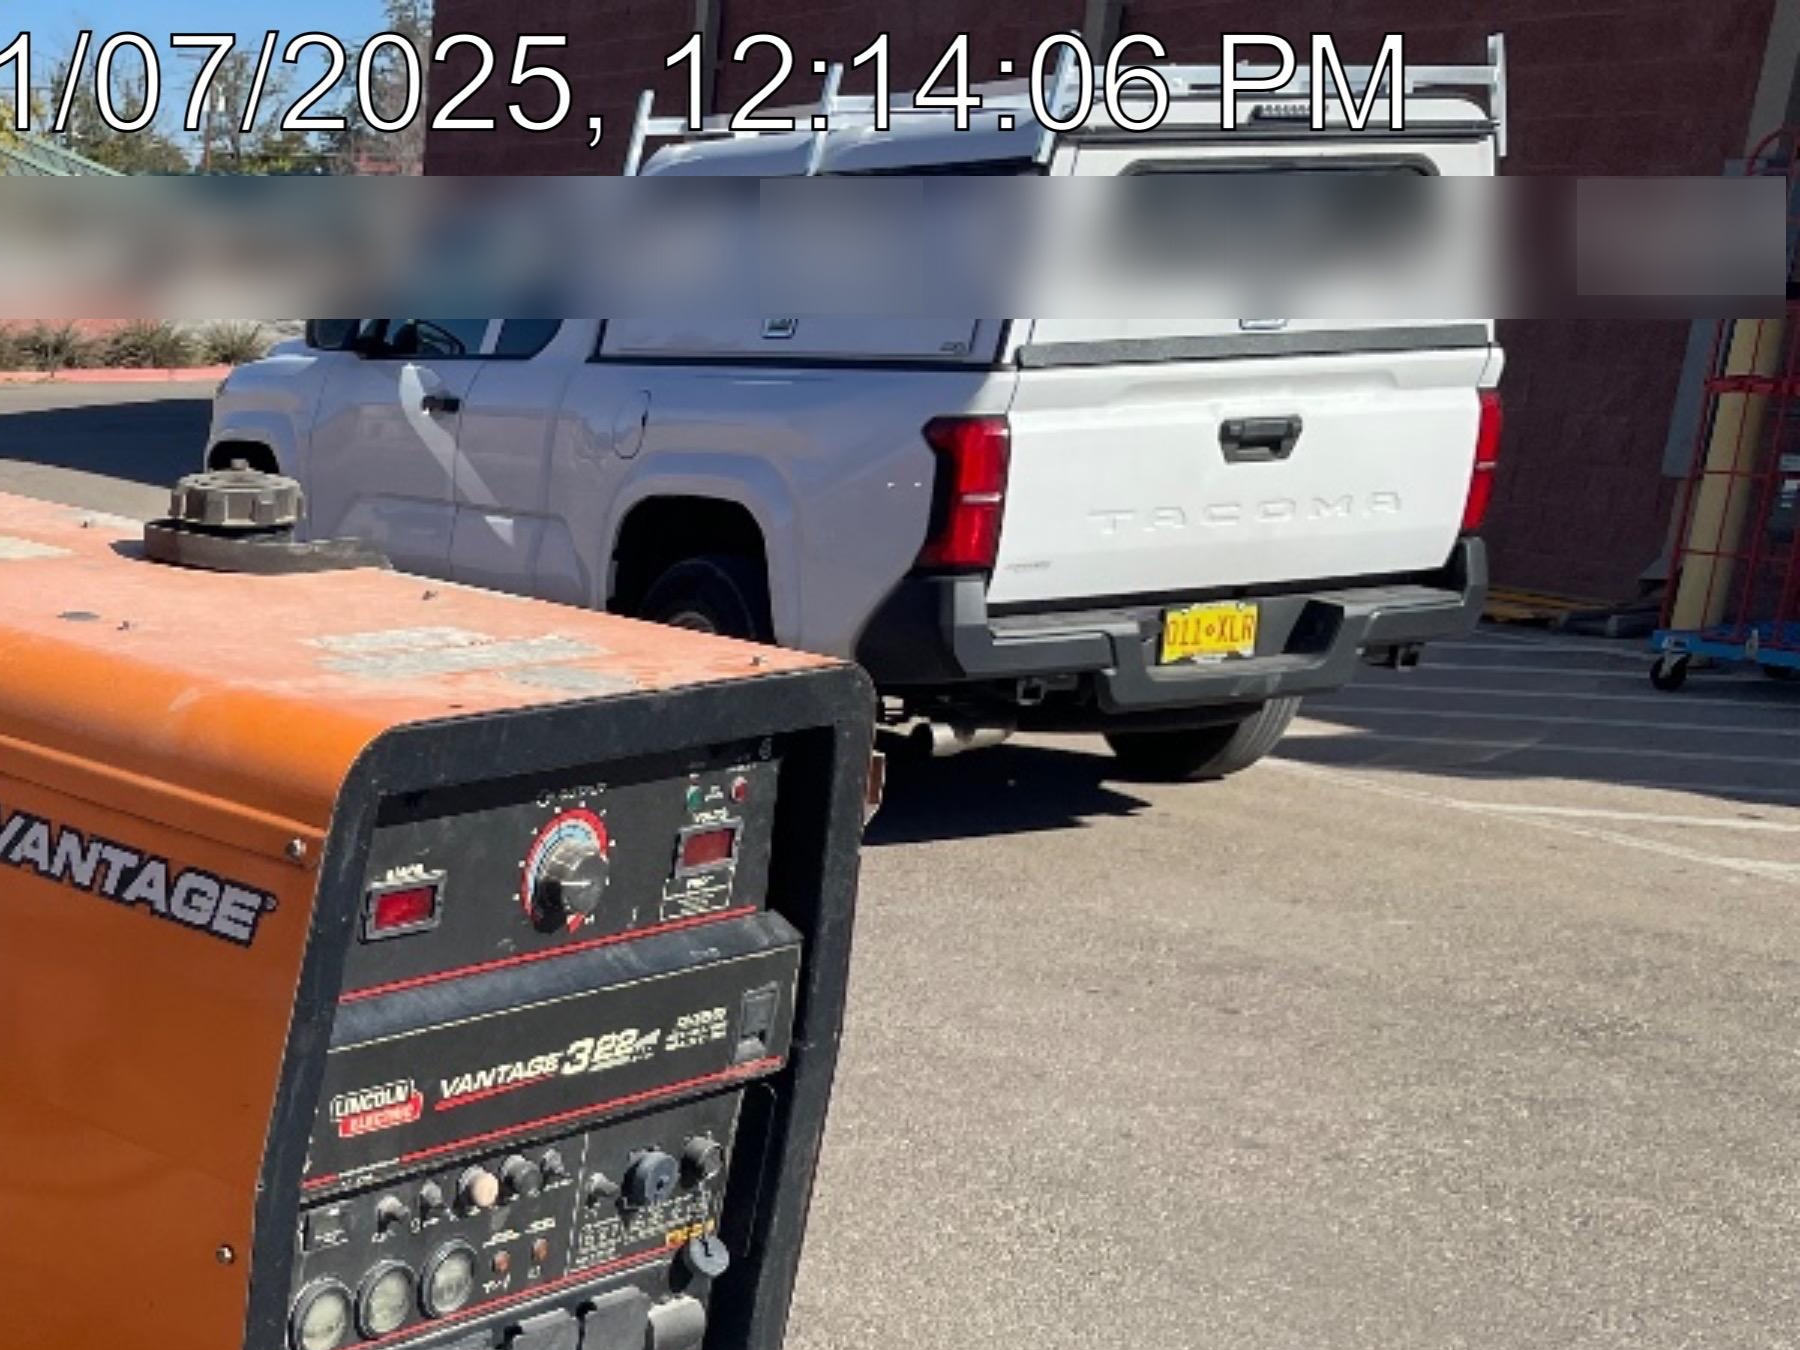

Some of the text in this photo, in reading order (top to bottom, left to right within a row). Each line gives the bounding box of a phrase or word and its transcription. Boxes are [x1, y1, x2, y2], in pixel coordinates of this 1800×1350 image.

[1087, 491, 1400, 534] TACOMA
[439, 1051, 564, 1098] VANTAGE
[335, 1084, 409, 1117] LINCOLN
